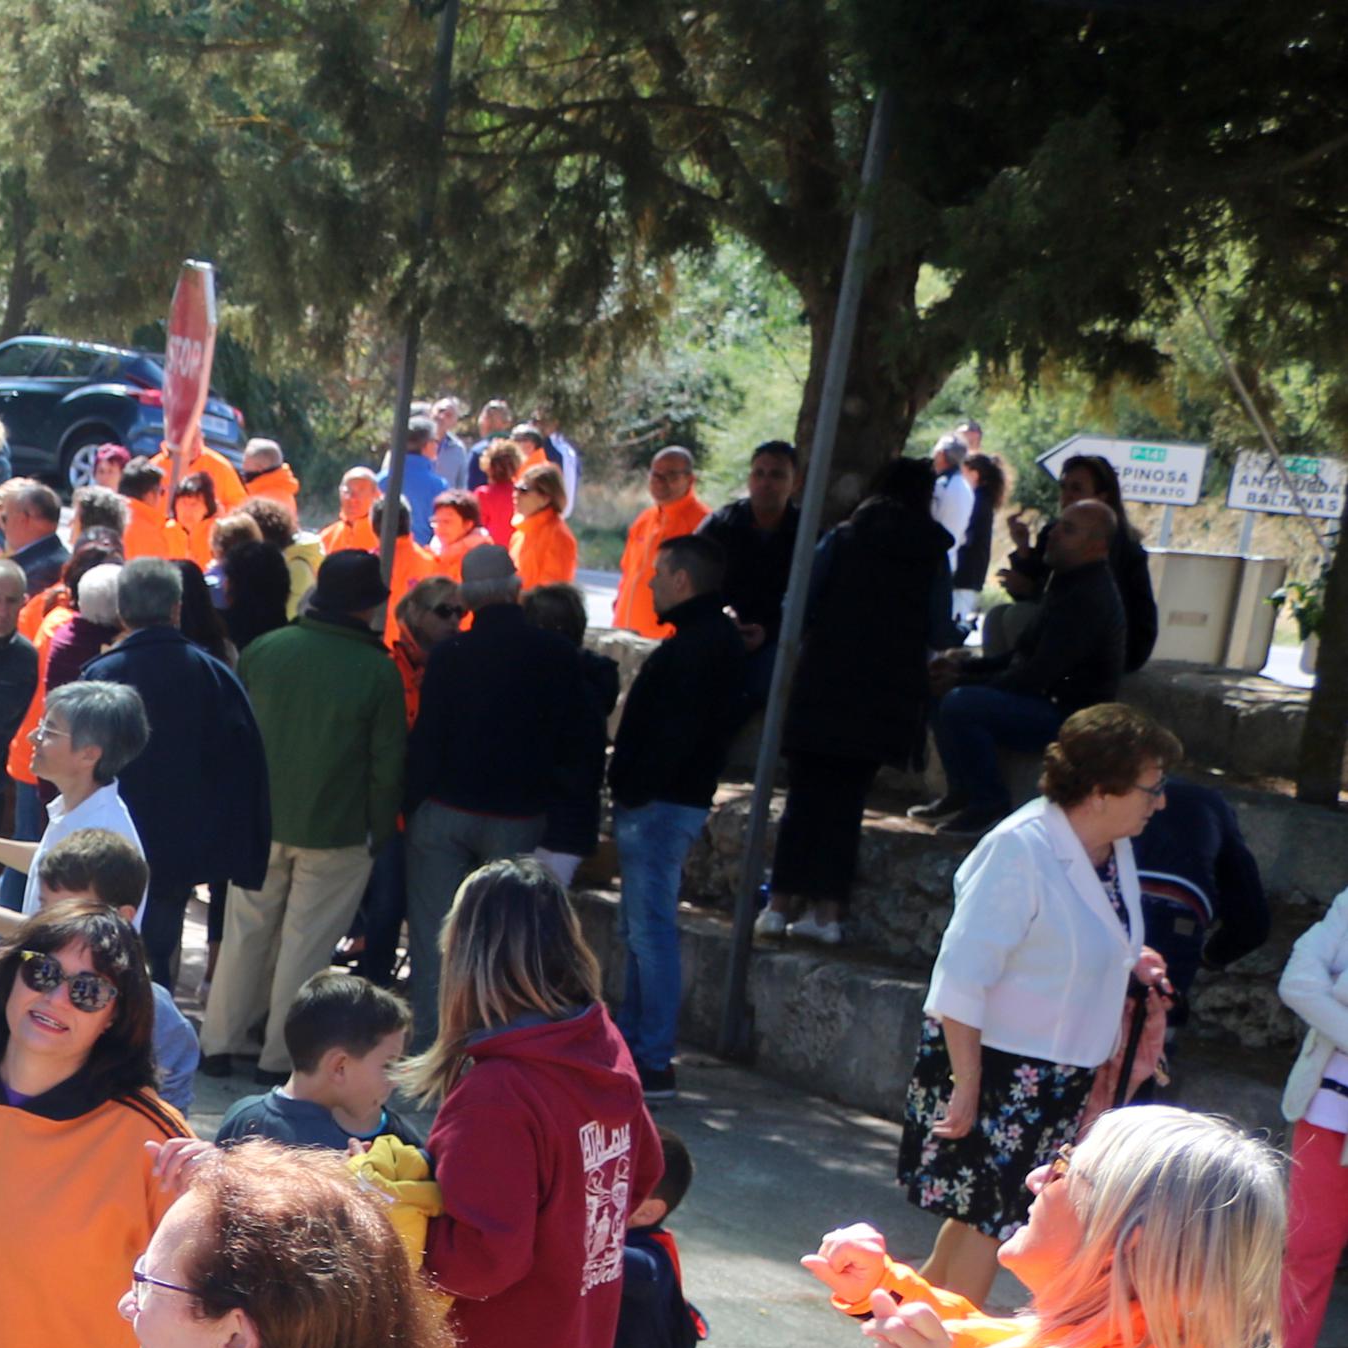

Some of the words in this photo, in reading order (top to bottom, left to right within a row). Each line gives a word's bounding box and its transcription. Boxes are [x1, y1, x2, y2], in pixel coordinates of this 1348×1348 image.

[167, 333, 203, 380] STOP
[1112, 464, 1188, 484] SPINOSA
[1122, 481, 1186, 498] CERRATO
